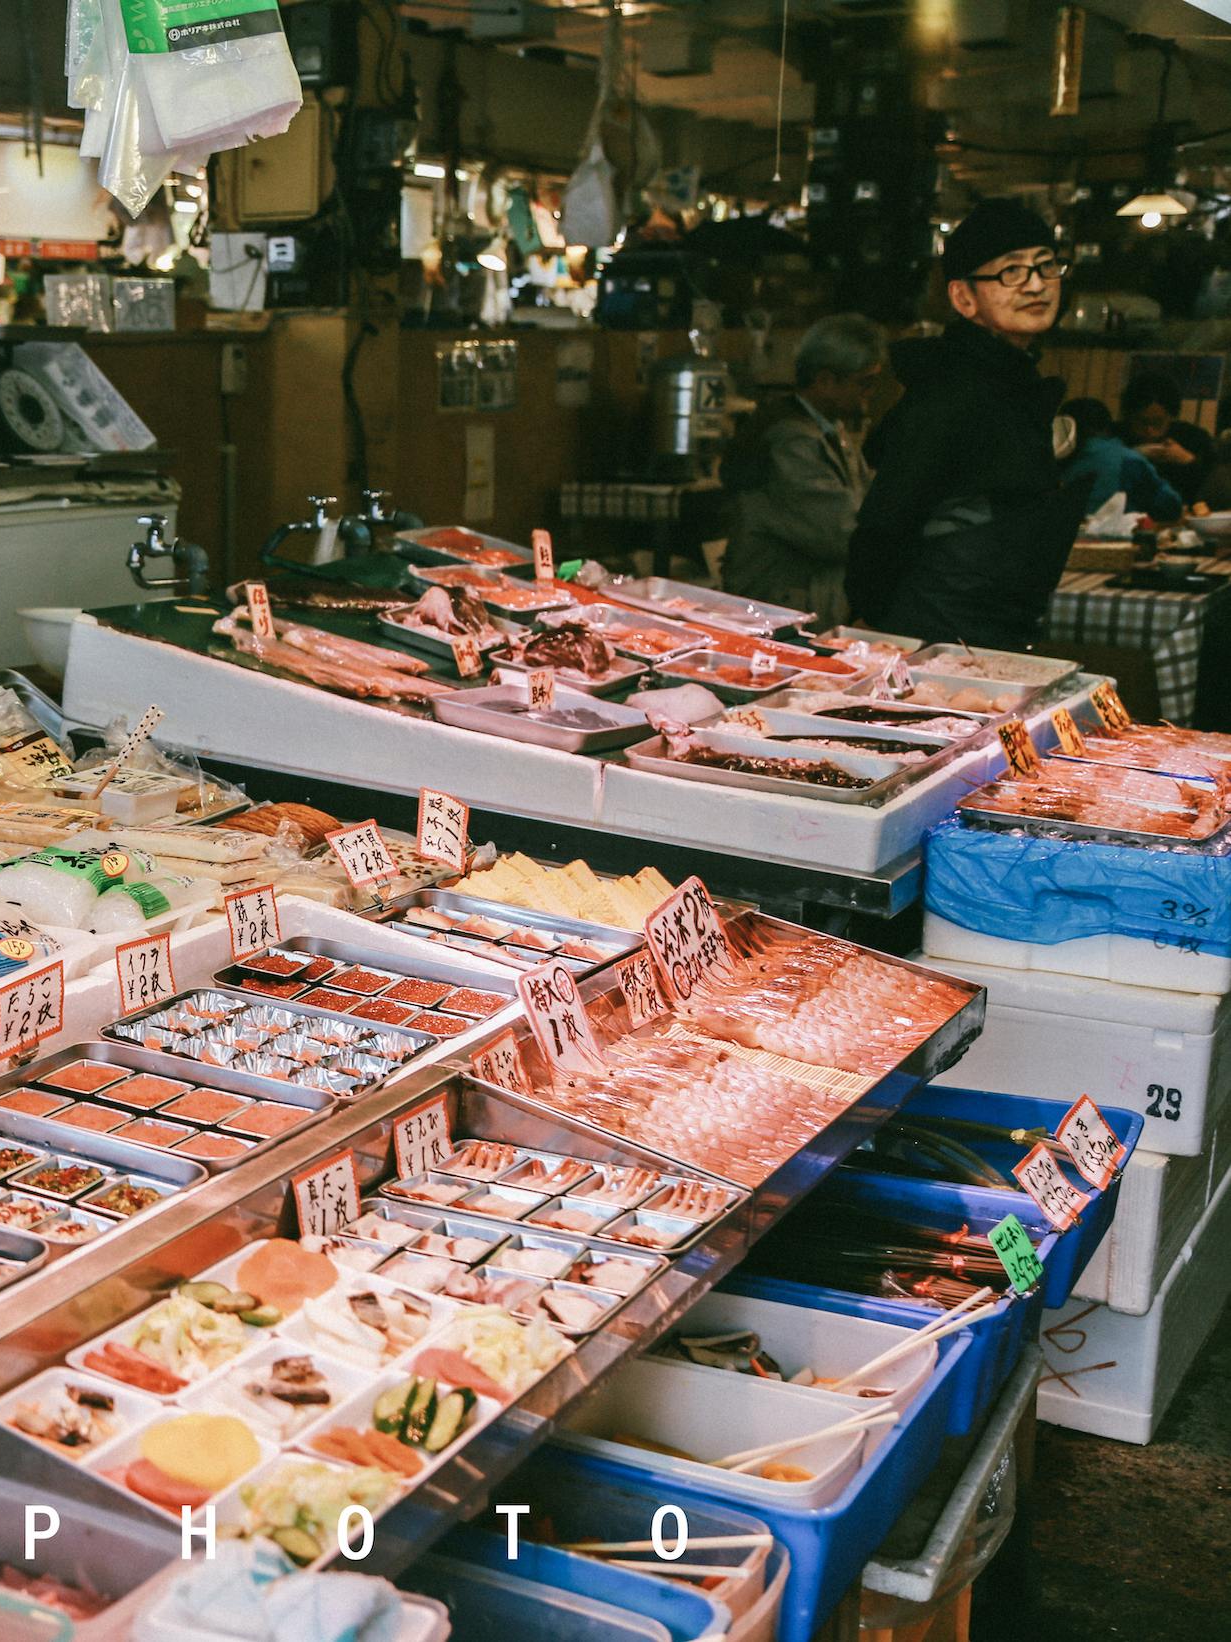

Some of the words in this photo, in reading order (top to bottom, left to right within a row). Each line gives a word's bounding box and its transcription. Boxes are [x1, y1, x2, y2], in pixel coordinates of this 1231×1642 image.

[338, 829, 381, 853] ホッキ貝
[348, 848, 392, 875] ¥2枚
[237, 915, 274, 946] ¥2枚
[1158, 899, 1211, 928] 3%
[127, 947, 160, 975] イクラ
[7, 977, 52, 1014] たらこ
[127, 971, 167, 1001] ¥2枚
[3, 1000, 57, 1042] ¥2枚
[1145, 1083, 1183, 1122] 29
[404, 1112, 439, 1146] 甘えび
[1067, 1117, 1089, 1151] ふき
[405, 1137, 446, 1177] ¥1枚
[307, 1165, 348, 1210] 真たこ
